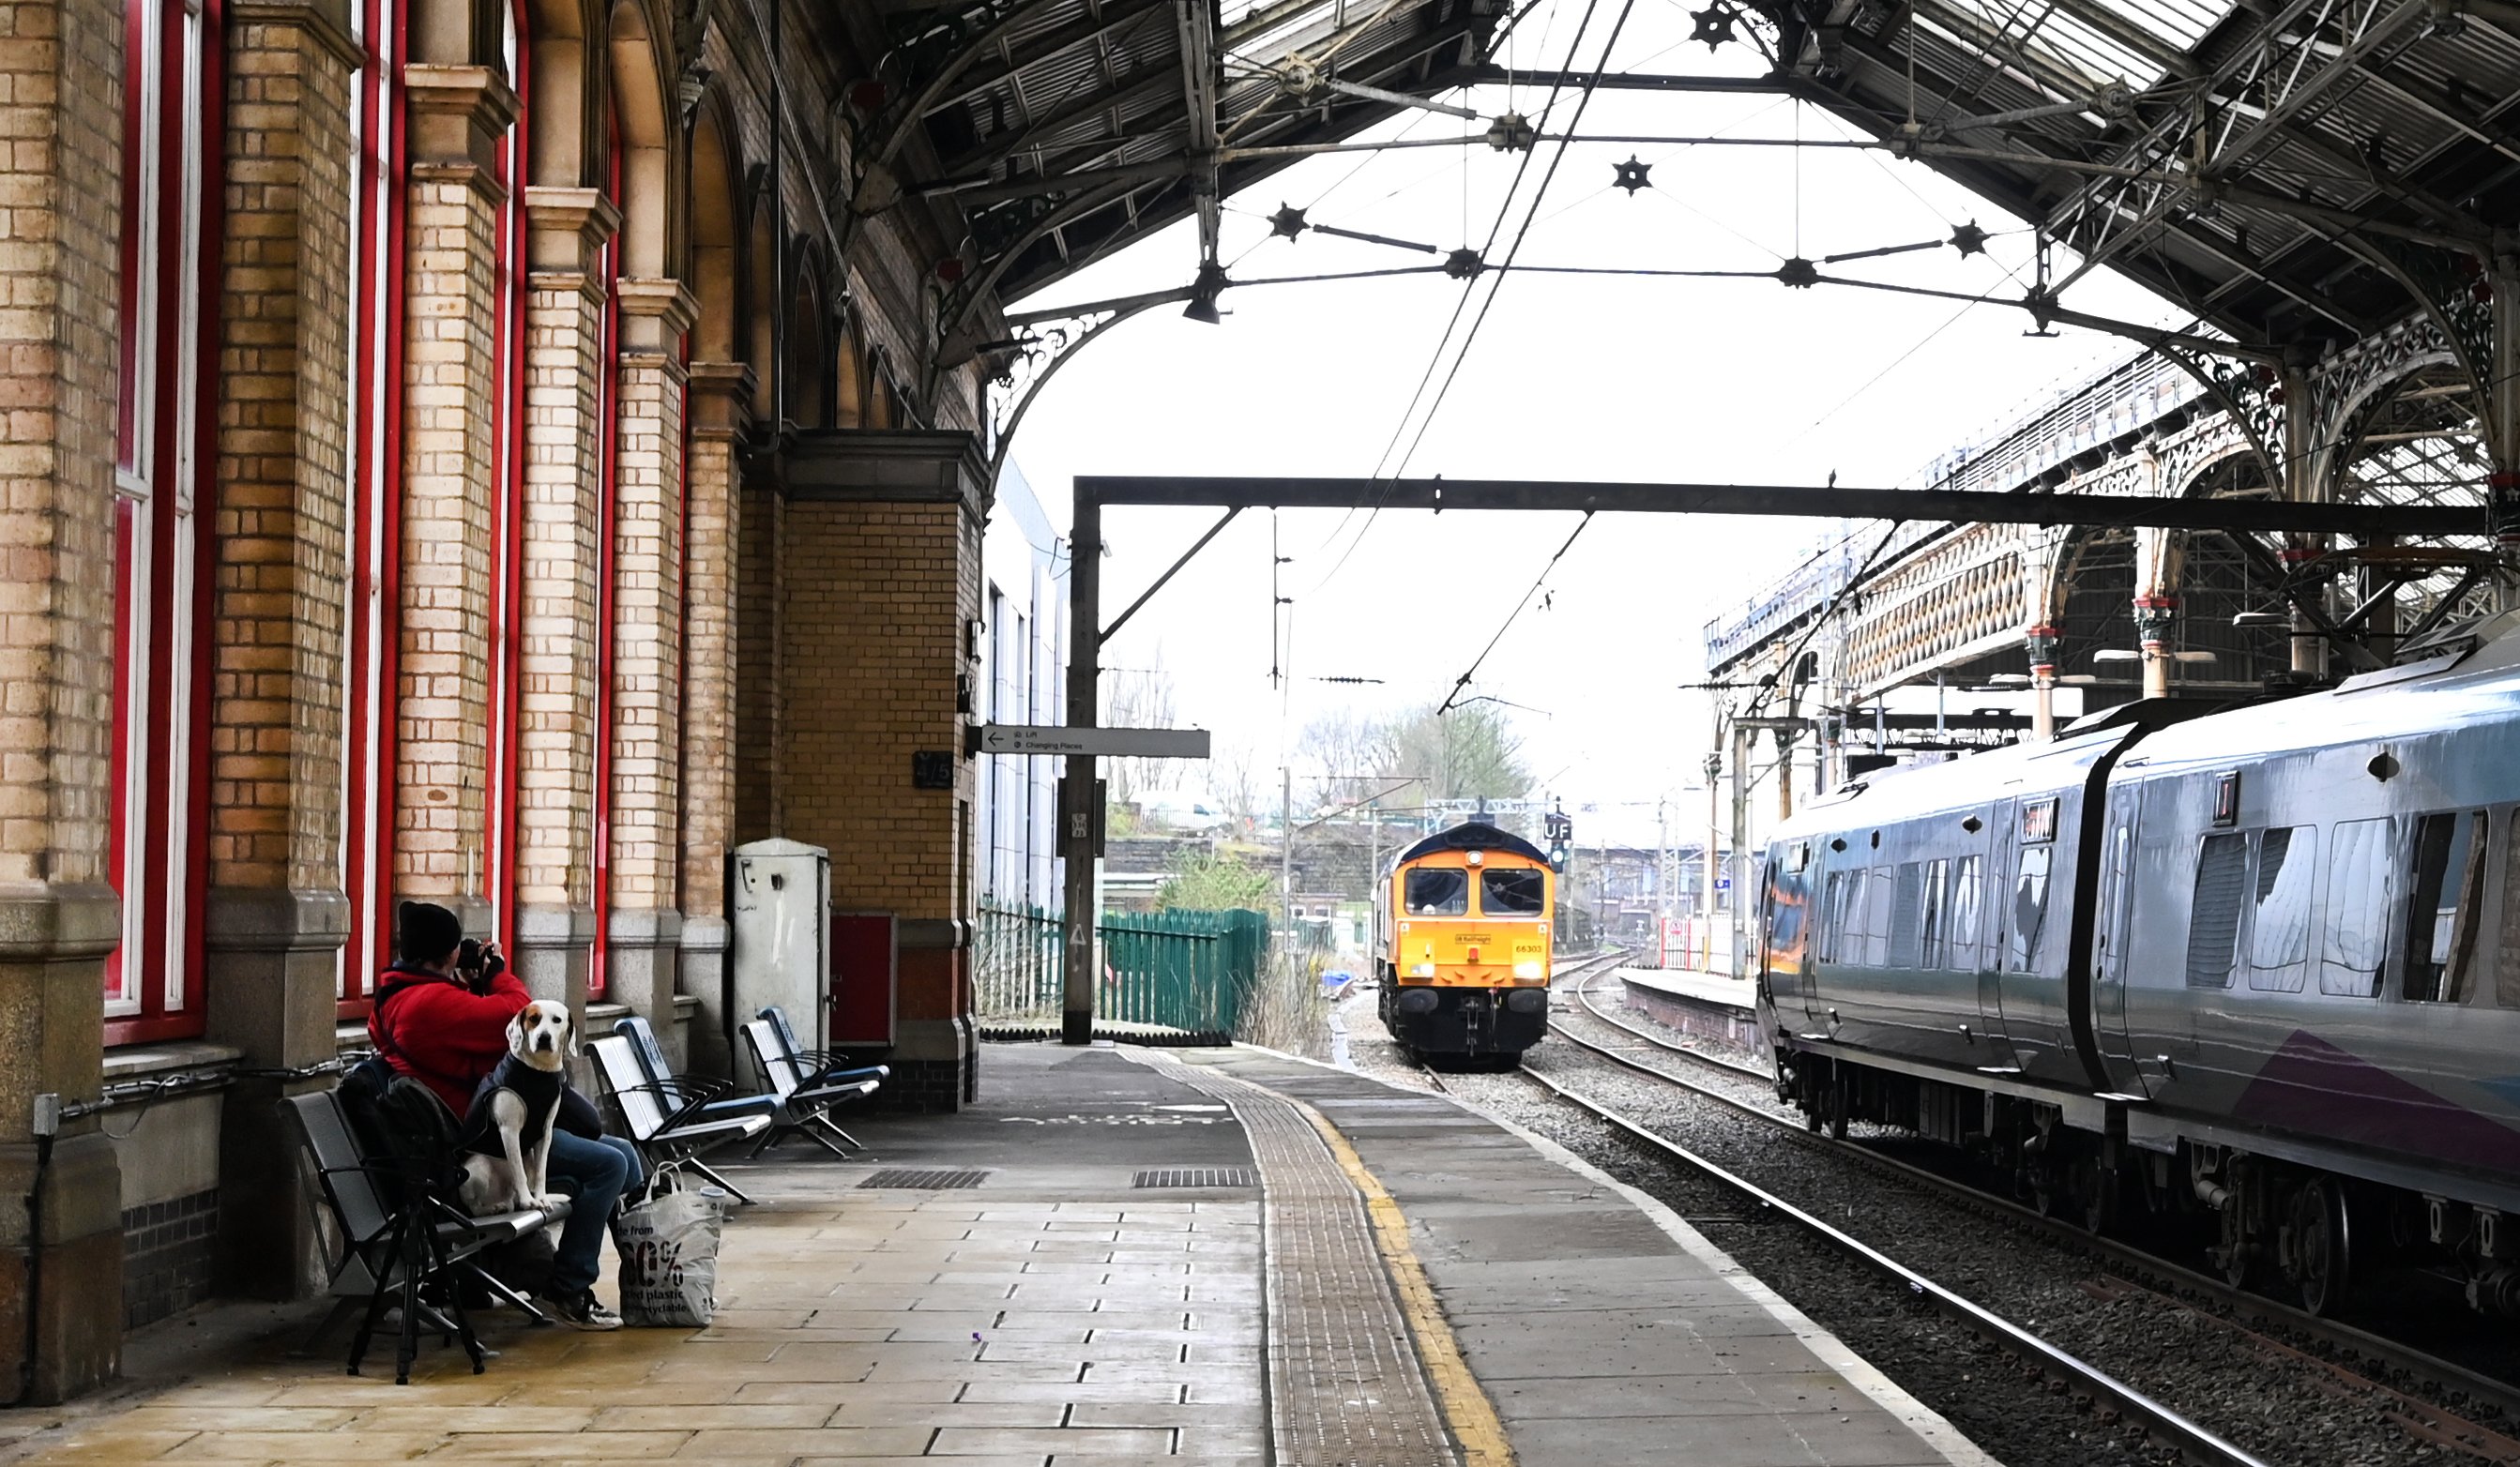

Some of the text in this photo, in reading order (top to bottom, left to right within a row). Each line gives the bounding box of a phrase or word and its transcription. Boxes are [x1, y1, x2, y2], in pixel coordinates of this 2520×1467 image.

[1025, 741, 1058, 750] Changing
[1515, 945, 1542, 953] 66303
[630, 1224, 654, 1236] from
[646, 1288, 684, 1303] plastic
